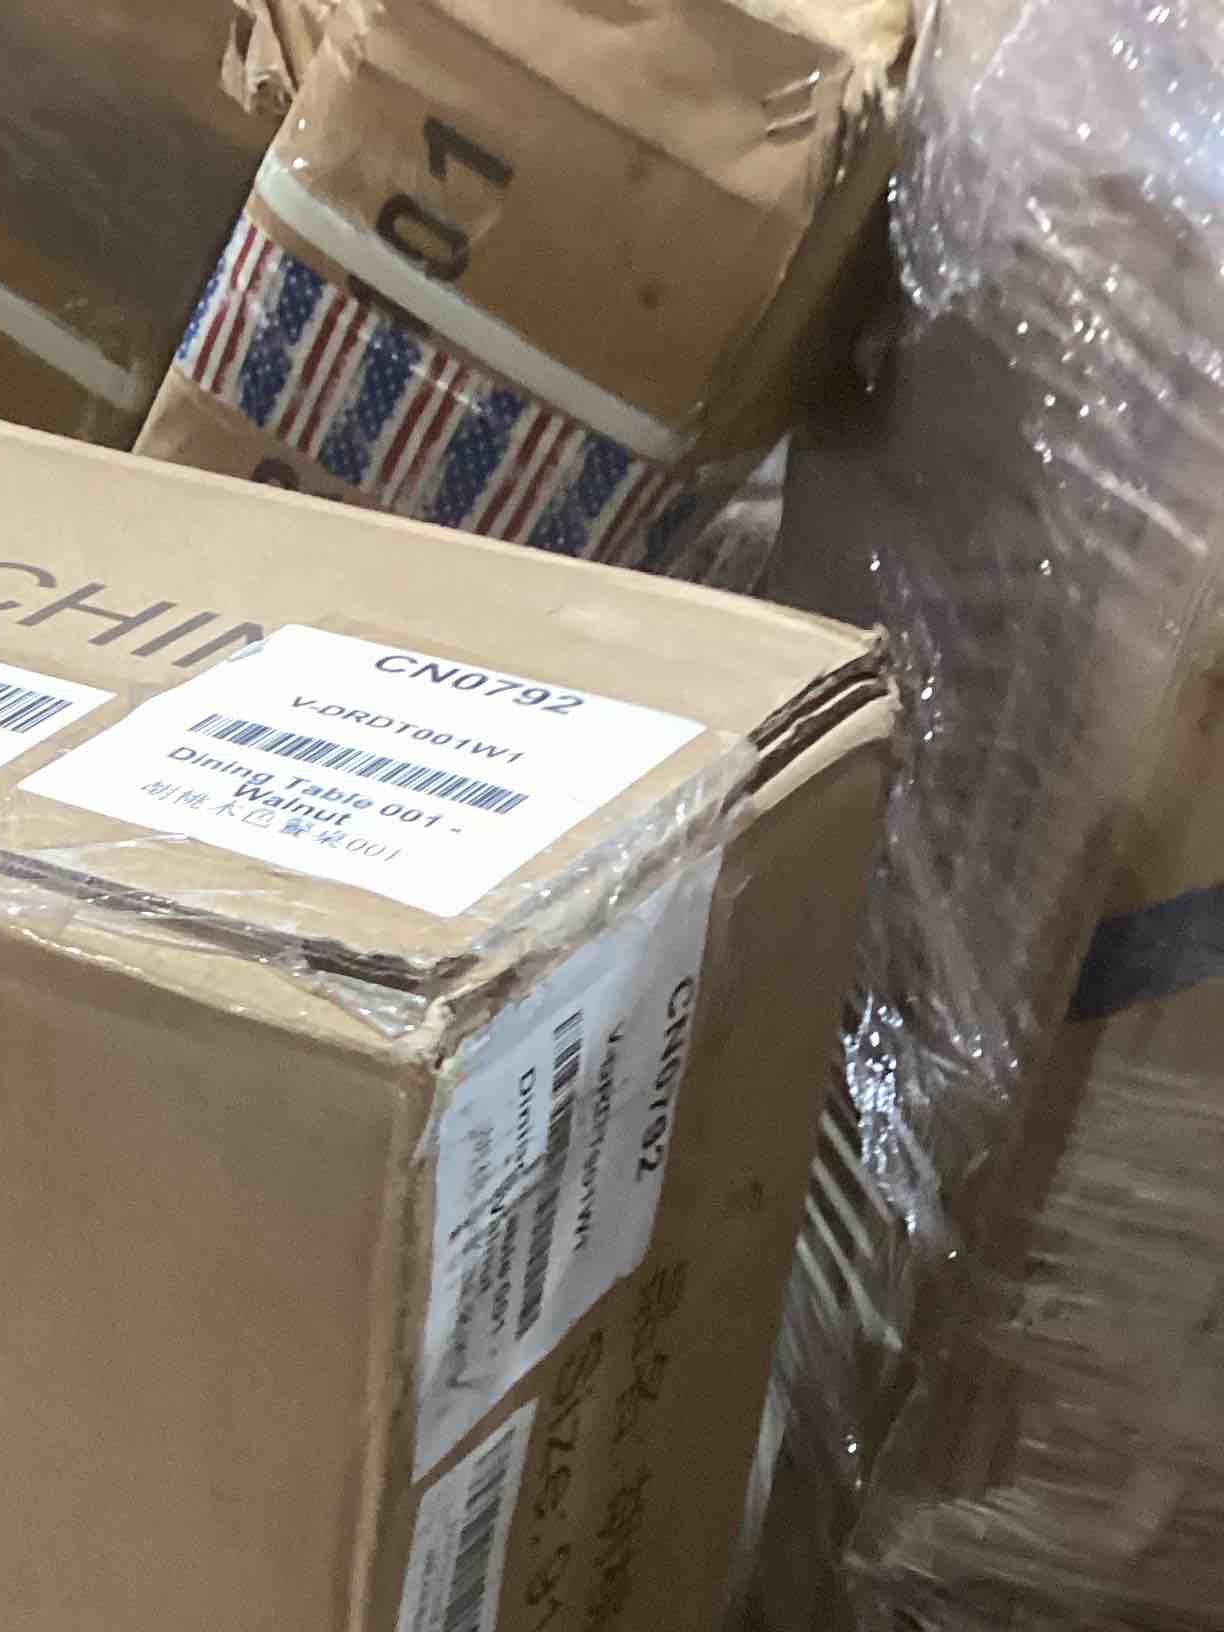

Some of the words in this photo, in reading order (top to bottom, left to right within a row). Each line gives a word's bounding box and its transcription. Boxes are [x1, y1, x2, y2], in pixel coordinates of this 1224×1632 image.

[374, 655, 585, 714] CN0792
[291, 696, 525, 763] V-DRDT001W1
[168, 746, 274, 785] Dining
[285, 776, 374, 809] Table
[379, 803, 443, 829] 001
[233, 784, 353, 826] Walnut
